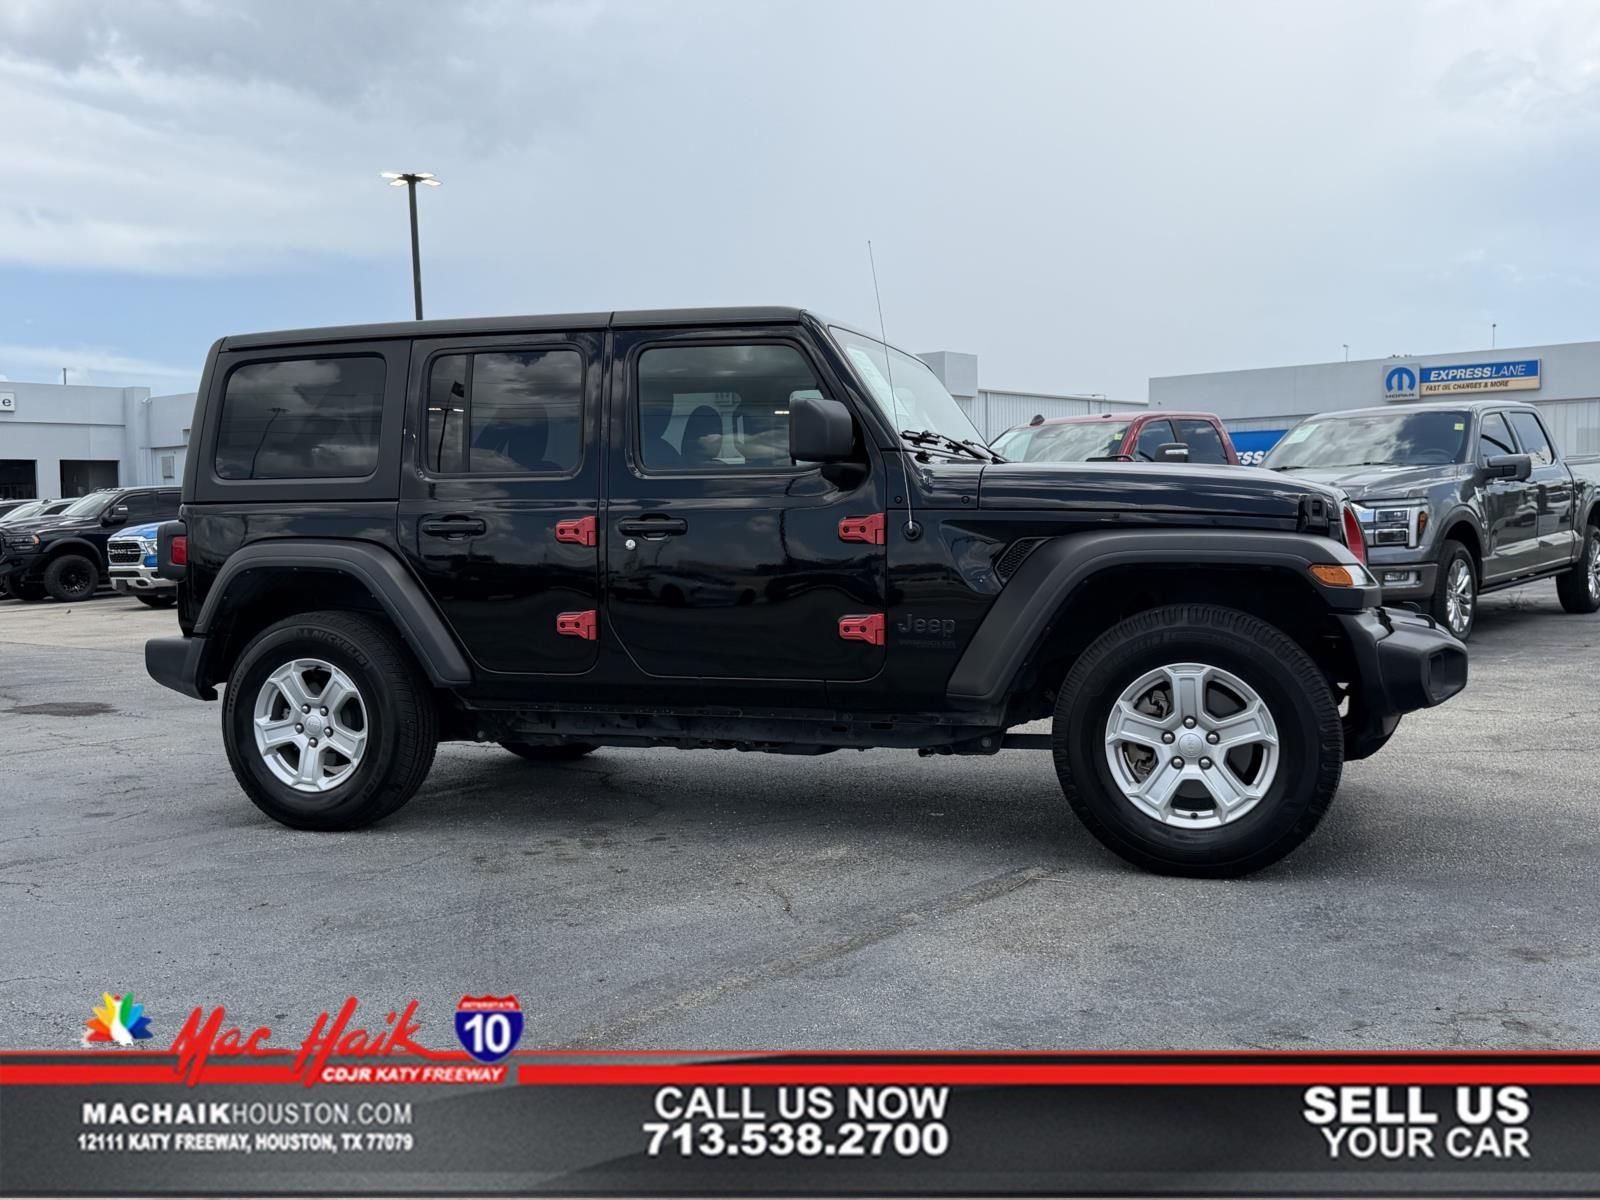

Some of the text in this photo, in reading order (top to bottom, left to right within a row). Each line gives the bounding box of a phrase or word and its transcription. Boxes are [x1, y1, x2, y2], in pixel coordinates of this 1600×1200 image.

[1430, 364, 1526, 381] EXPRESSLANE
[1425, 384, 1440, 392] FAST
[1441, 383, 1451, 391] OIL
[1453, 381, 1482, 390] CHANGES
[1490, 380, 1509, 388] MORE
[897, 613, 956, 638] Jeep
